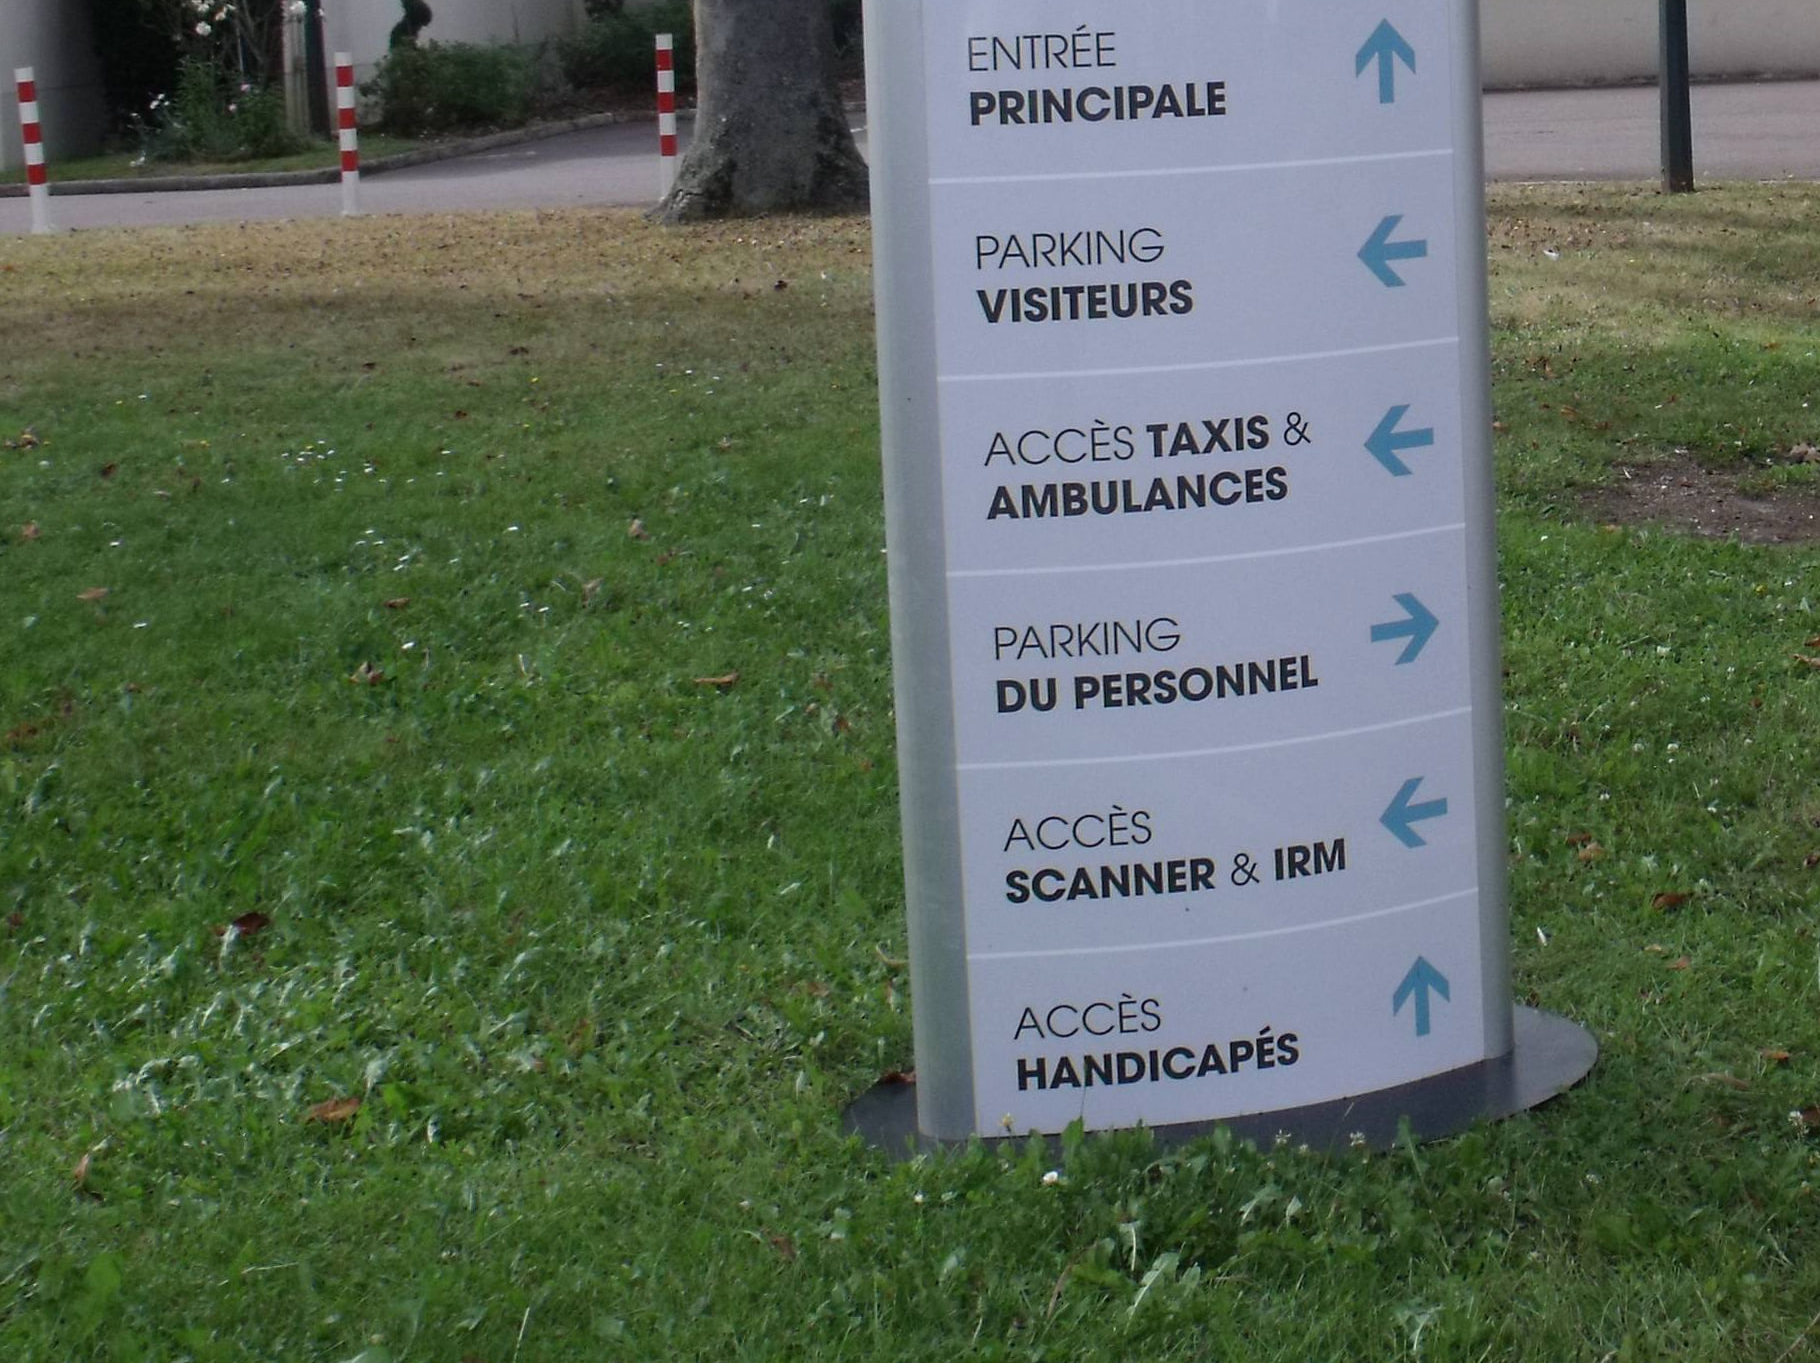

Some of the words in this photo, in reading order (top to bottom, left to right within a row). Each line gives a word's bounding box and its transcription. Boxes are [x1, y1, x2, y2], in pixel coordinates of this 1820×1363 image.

[968, 24, 1117, 72] ENTRÉE
[969, 81, 1226, 126] PRINCIPALE
[975, 227, 1165, 270] PARKING
[976, 280, 1194, 324] VISITEURS
[983, 420, 1135, 467] ACCÈS
[1146, 415, 1270, 459] TAXIS
[1283, 412, 1312, 446] &
[986, 466, 1288, 521] AMBULANCES
[993, 617, 1181, 661] PARKING
[996, 677, 1057, 713] DU
[1073, 654, 1319, 710] PERSONNEL
[1004, 804, 1152, 852] ACCÈS
[1005, 856, 1215, 903] SCANNER
[1230, 852, 1260, 886] &
[1274, 838, 1347, 881] IRM
[1014, 992, 1161, 1040] ACCÈS
[1017, 1025, 1300, 1091] HANDICAPÉS
